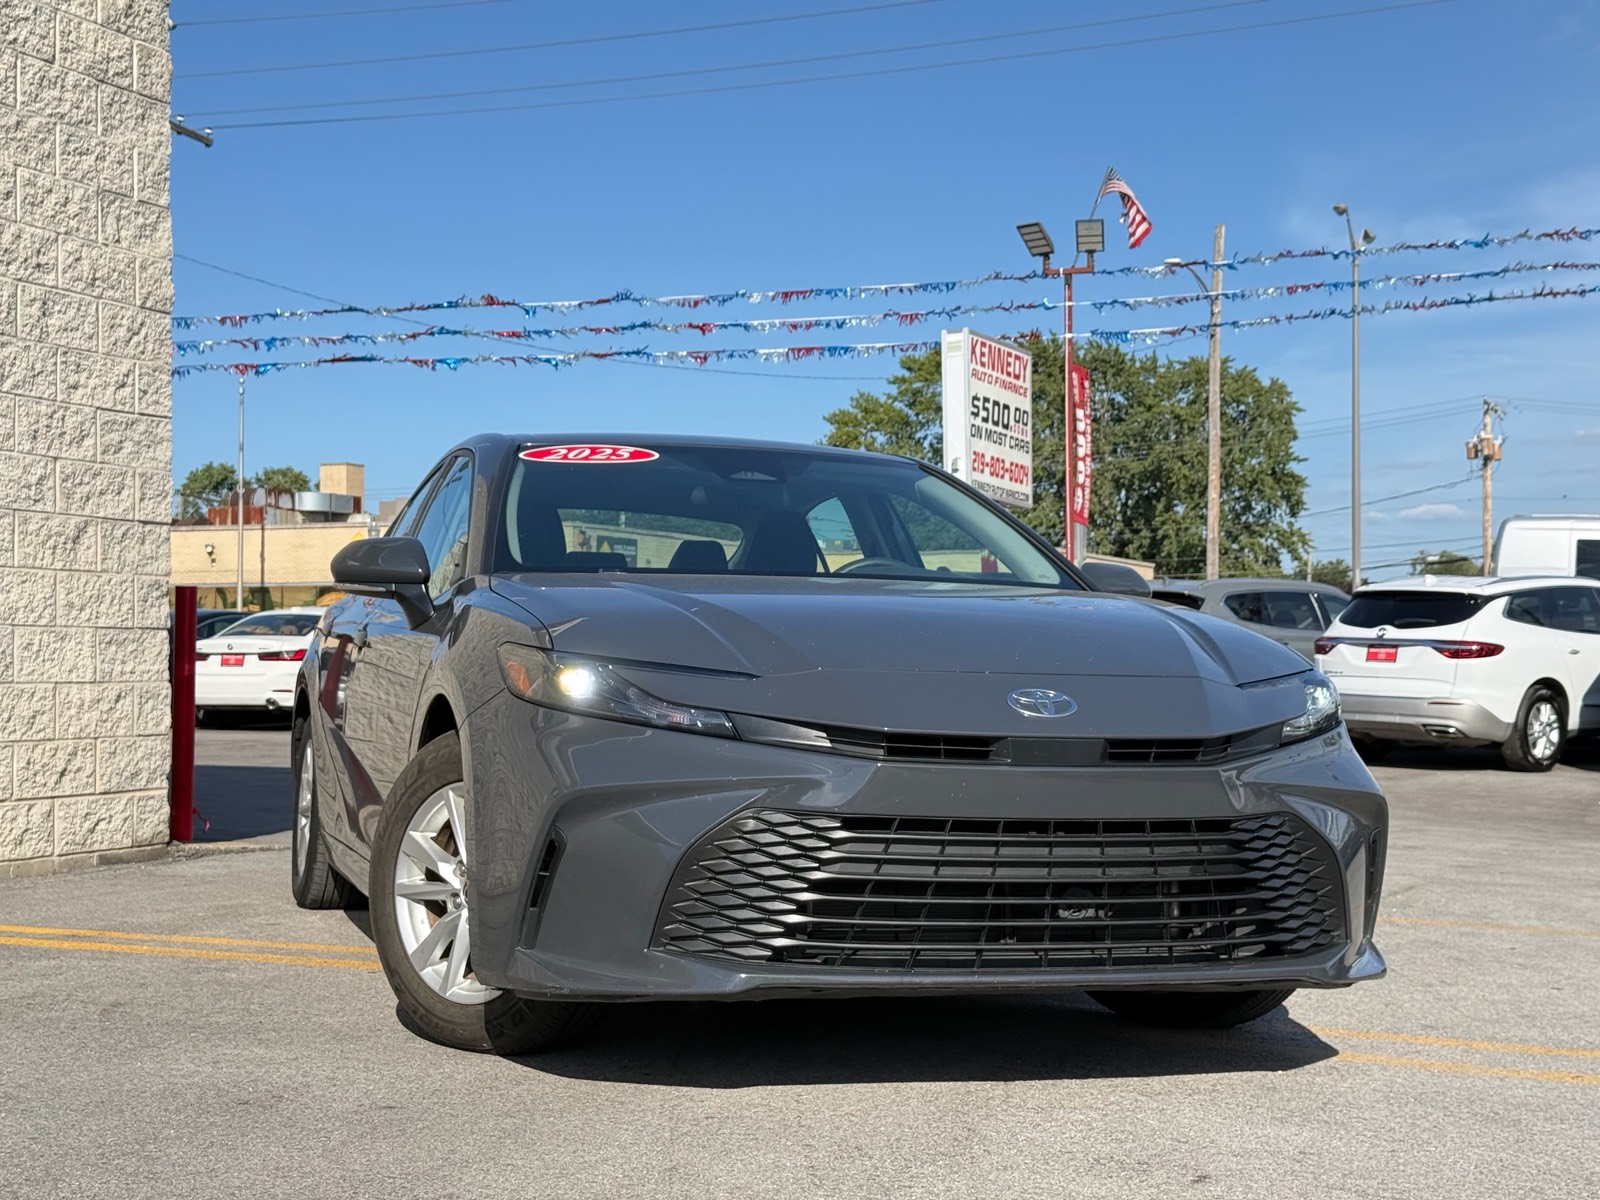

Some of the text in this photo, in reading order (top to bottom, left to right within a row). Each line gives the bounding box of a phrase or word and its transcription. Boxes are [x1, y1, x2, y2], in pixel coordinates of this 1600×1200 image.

[971, 336, 1029, 383] KENNEDY
[971, 368, 1028, 398] AUTO FINANCE
[543, 447, 634, 460] 2025
[970, 423, 983, 440] ON
[984, 427, 1008, 447] MOST
[1009, 436, 1030, 454] CARS
[972, 450, 1029, 487] 219-803-6004
